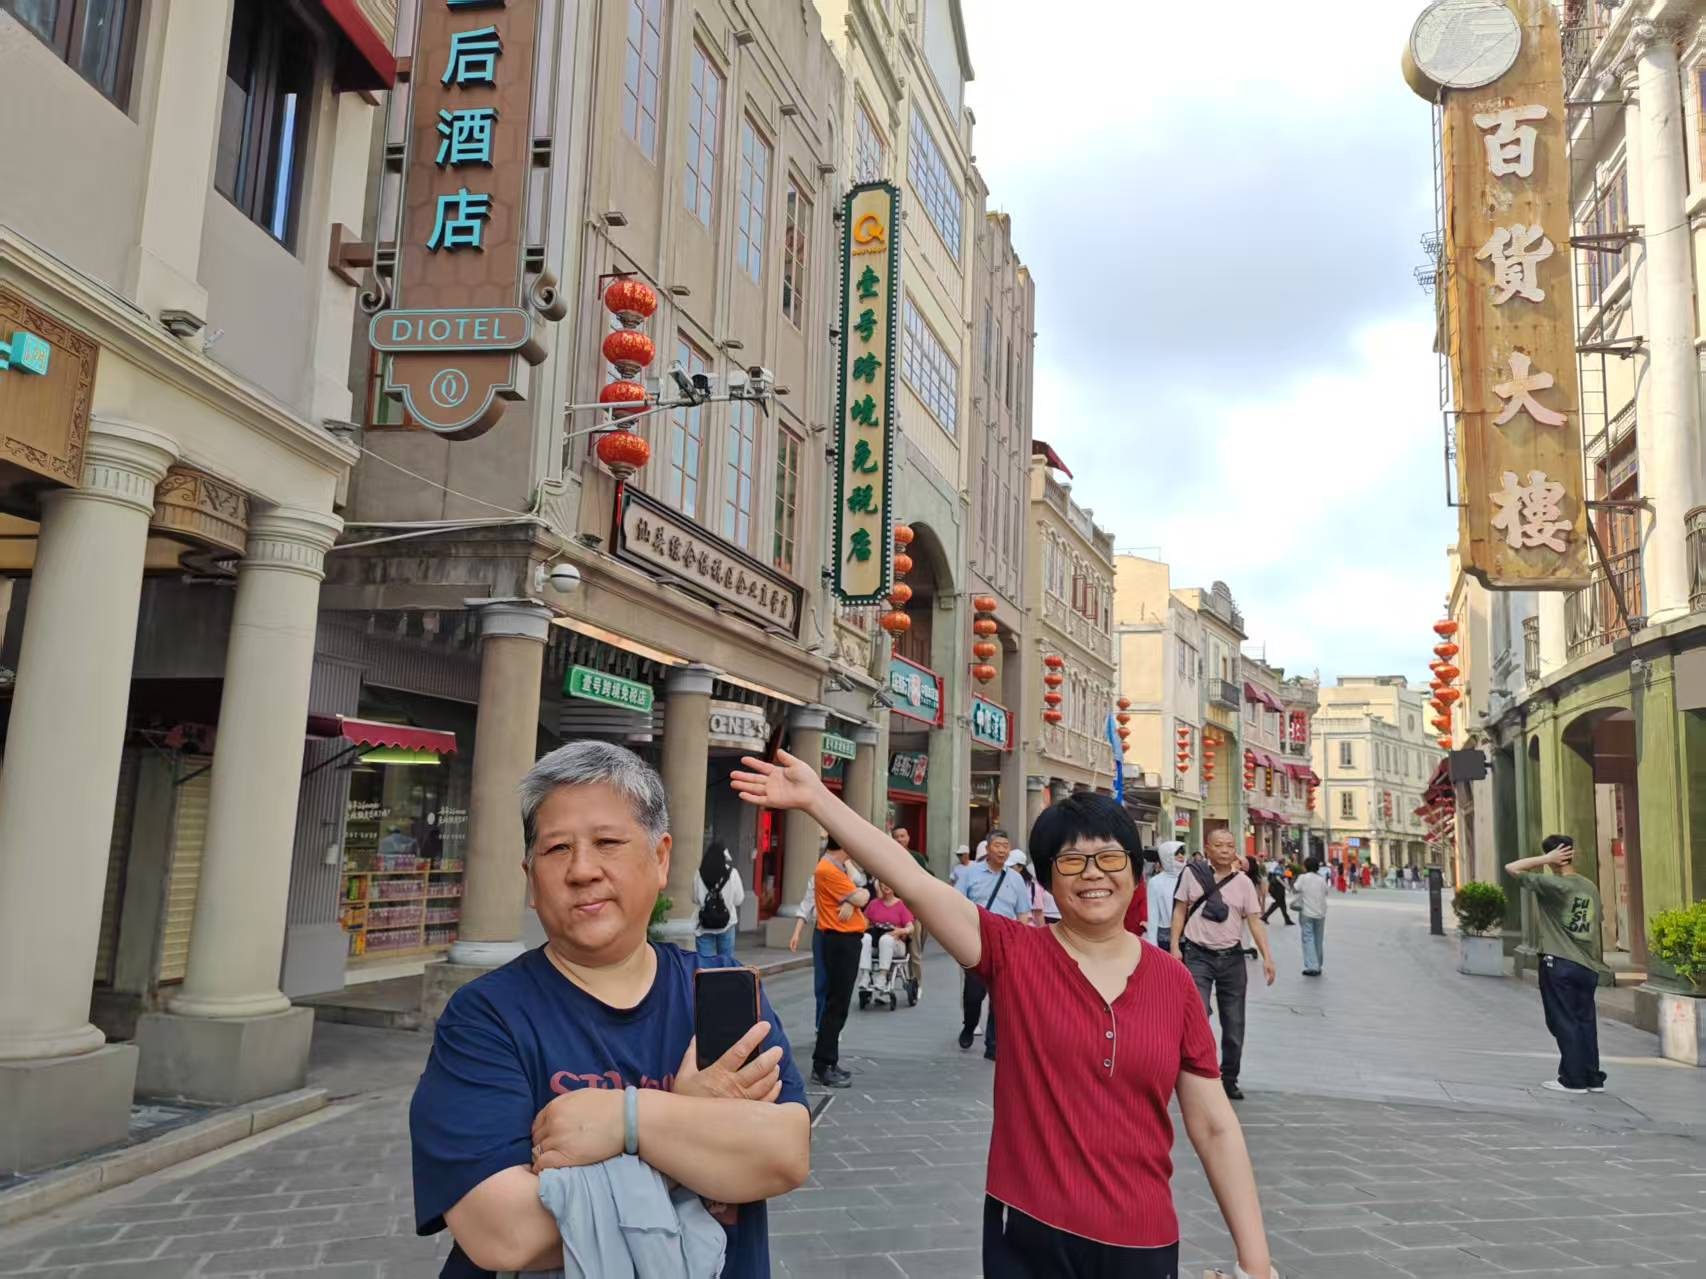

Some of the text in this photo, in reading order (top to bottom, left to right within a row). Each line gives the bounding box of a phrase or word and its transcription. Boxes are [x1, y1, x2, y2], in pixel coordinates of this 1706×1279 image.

[426, 0, 504, 253] 后酒店
[391, 318, 507, 341] DIOTEL
[1471, 103, 1574, 553] 百貨大樓
